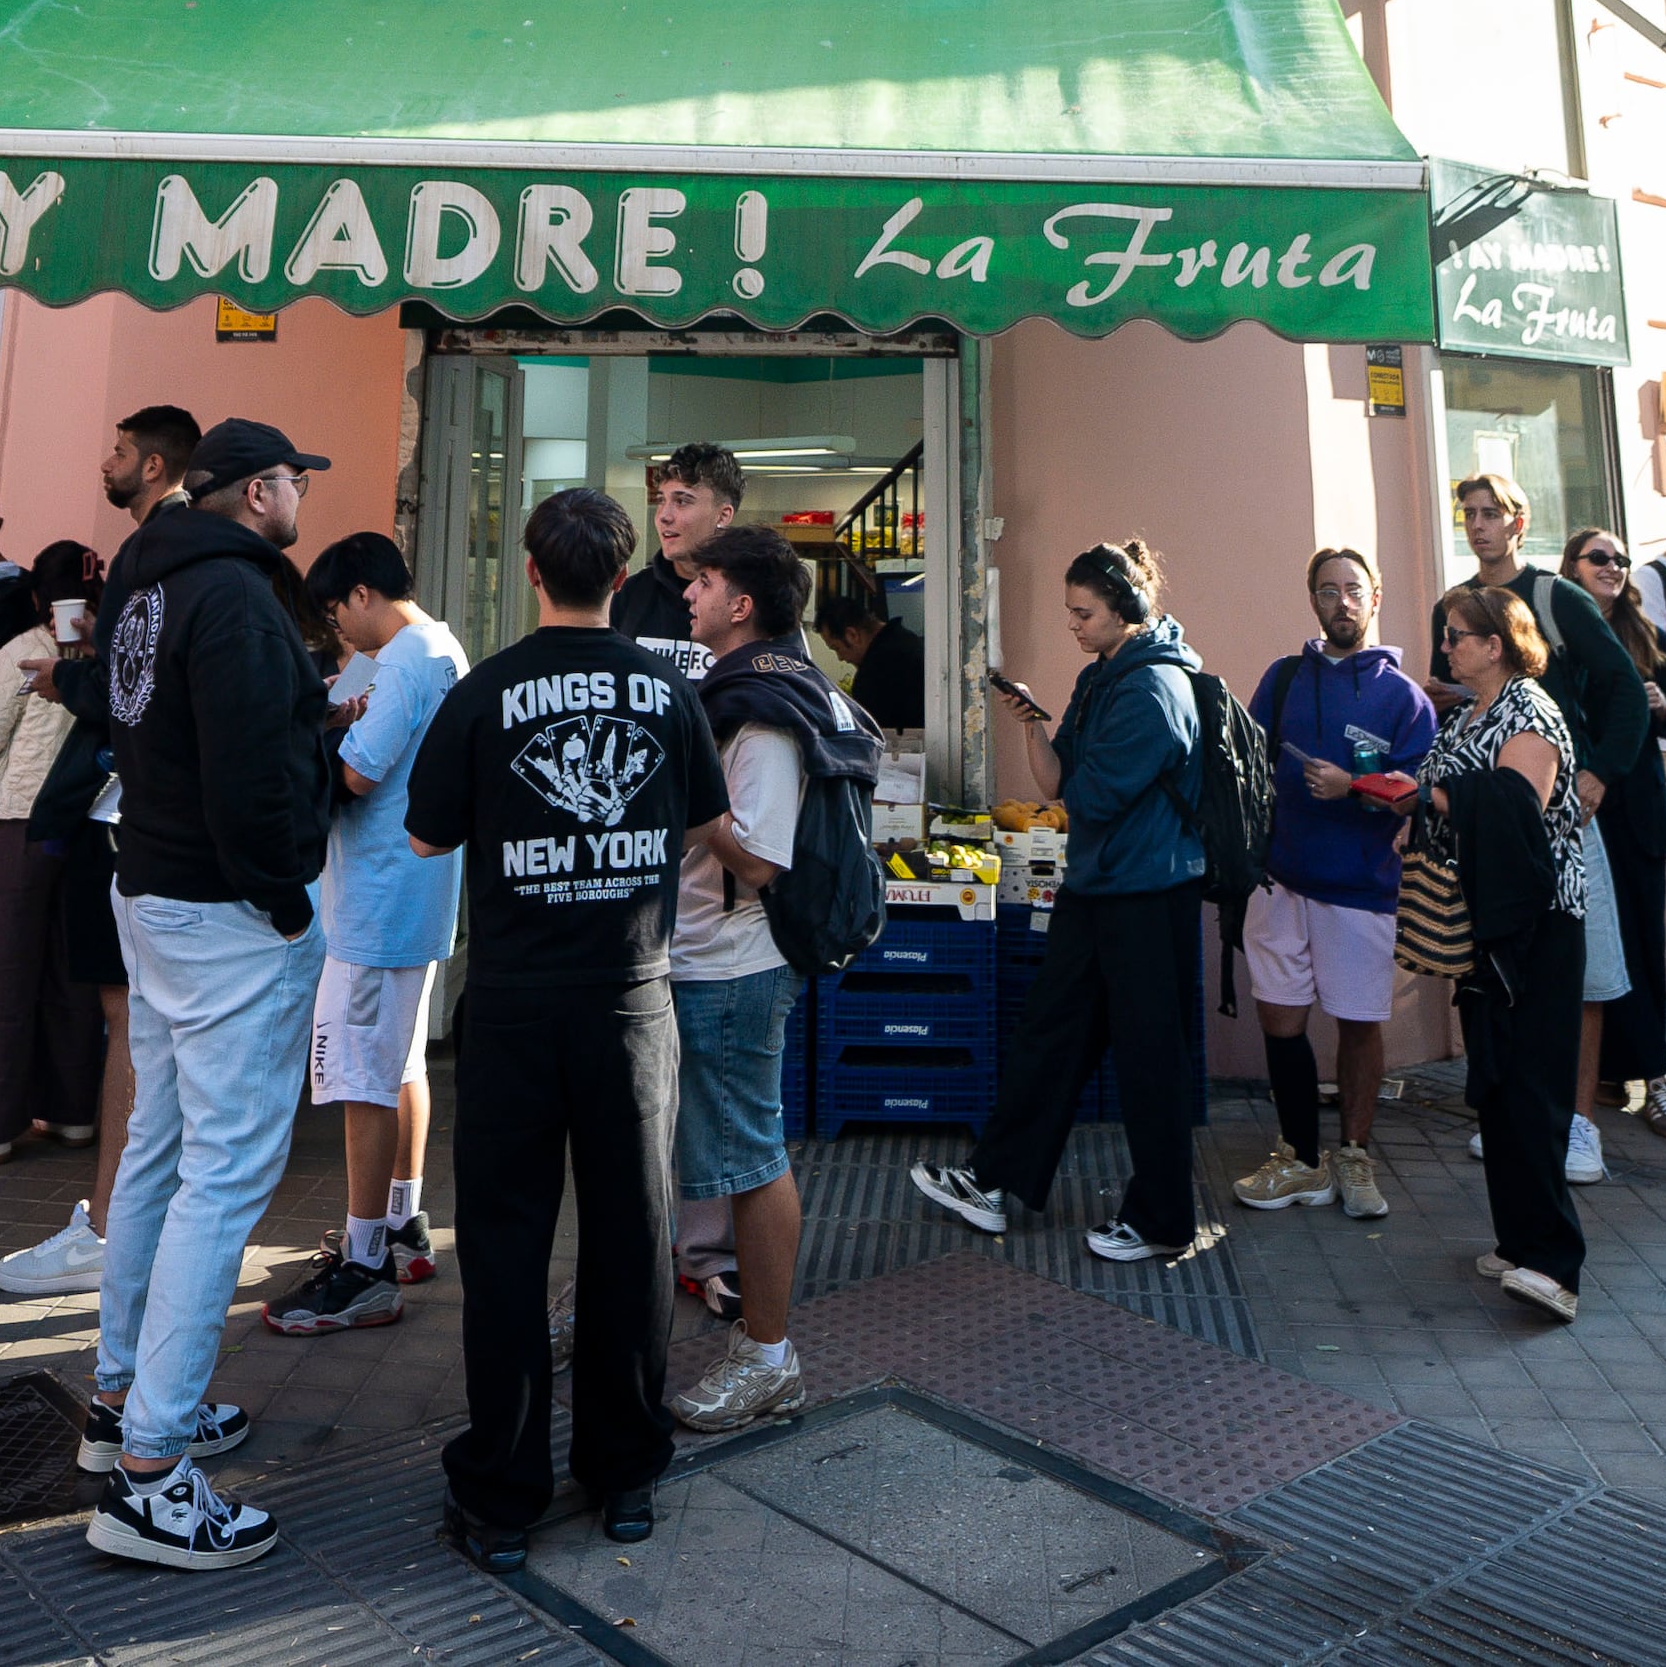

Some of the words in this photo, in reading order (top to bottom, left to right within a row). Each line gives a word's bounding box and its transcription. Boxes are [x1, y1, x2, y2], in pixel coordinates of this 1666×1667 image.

[854, 197, 990, 284] La
[1042, 202, 1376, 308] Fruta
[1452, 273, 1503, 329] La
[1511, 282, 1617, 345] Fruta
[501, 672, 616, 730] KINGS
[627, 672, 672, 717] OF
[502, 835, 577, 877] NEW
[585, 828, 669, 870] YORK
[543, 881, 571, 893] BEST
[572, 877, 603, 890] TEAM
[604, 875, 642, 888] ACROSS
[643, 874, 660, 885] THE
[546, 893, 573, 904] FIVE
[883, 950, 928, 963] Plasencia
[884, 1024, 929, 1036] Plasencia
[313, 1034, 329, 1086] NIKE
[884, 1097, 929, 1110] Plasencia
